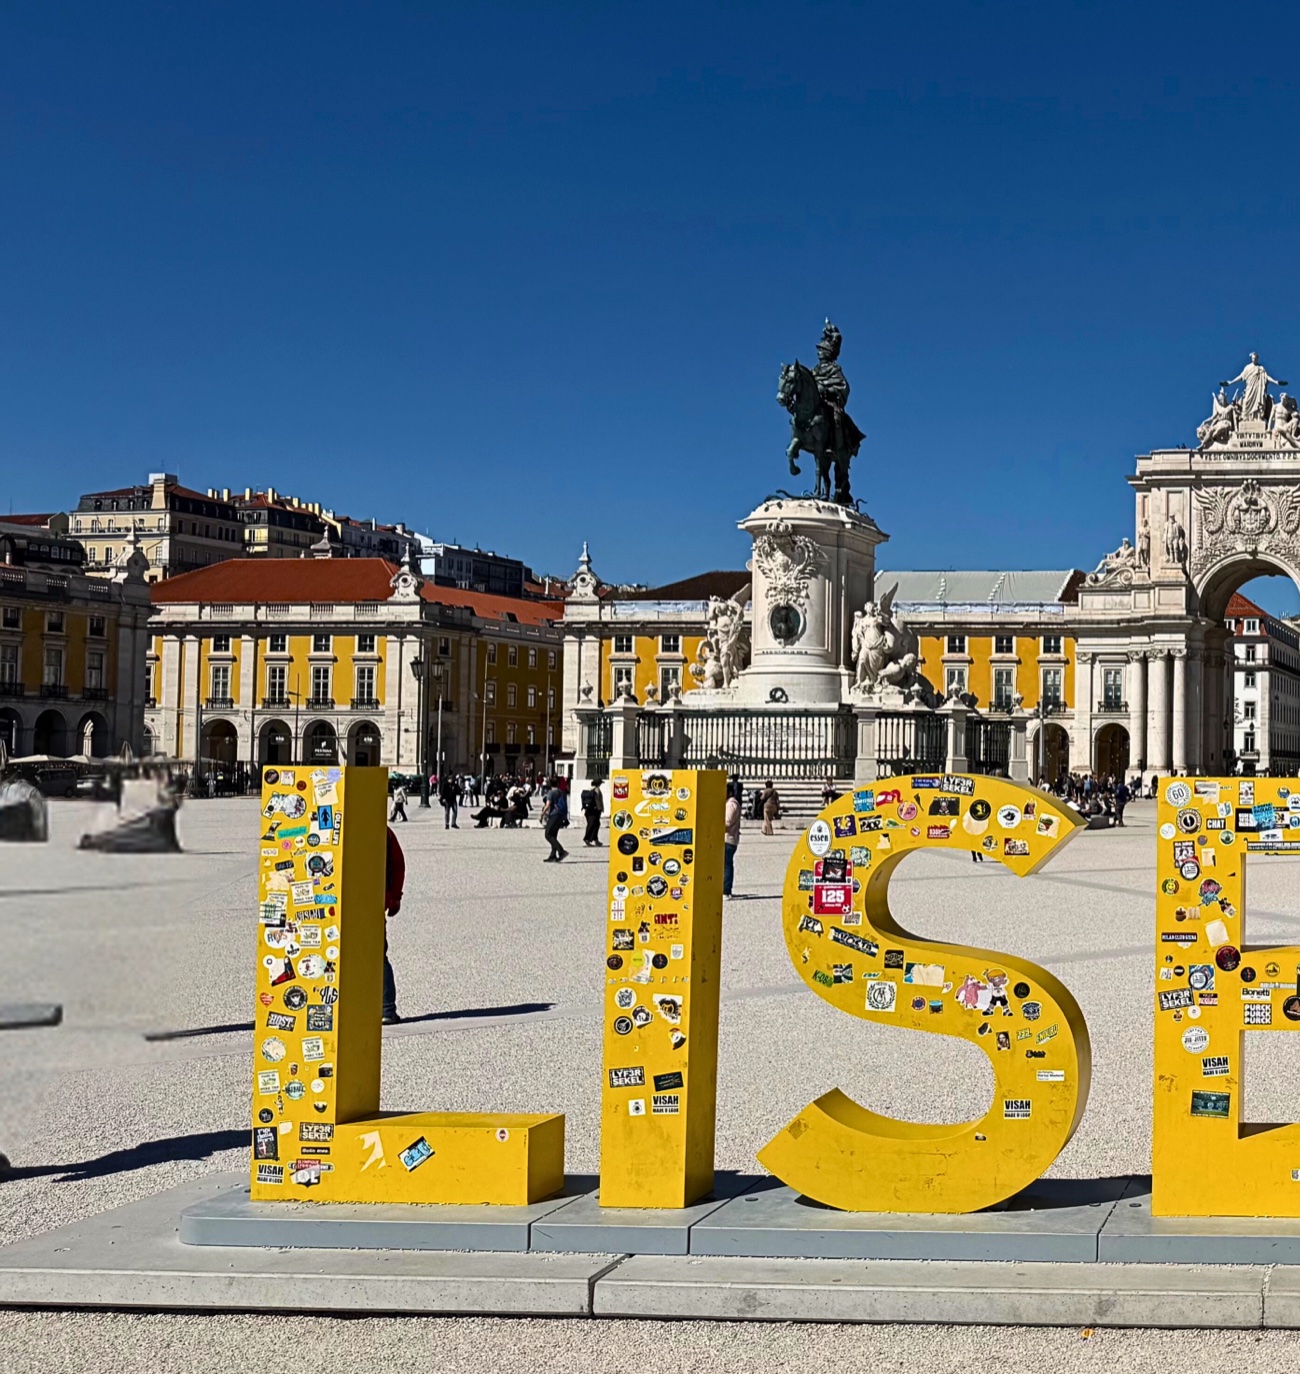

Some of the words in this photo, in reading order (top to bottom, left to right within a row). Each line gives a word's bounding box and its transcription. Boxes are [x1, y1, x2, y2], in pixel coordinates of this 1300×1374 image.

[1172, 788, 1184, 799] 60
[1207, 820, 1225, 828] CHAT
[822, 890, 844, 903] 125
[1161, 990, 1190, 1001] LYF3R
[1162, 997, 1192, 1008] SEKEL
[269, 1013, 294, 1028] HOST
[1202, 1057, 1228, 1068] VISAH
[612, 1070, 641, 1078] LYF3R
[612, 1077, 643, 1086] SEKEL
[653, 1096, 678, 1104] VISAH
[1005, 1100, 1030, 1109] VISAH
[302, 1124, 331, 1133] LYF3R
[258, 1164, 284, 1175] VISAH
